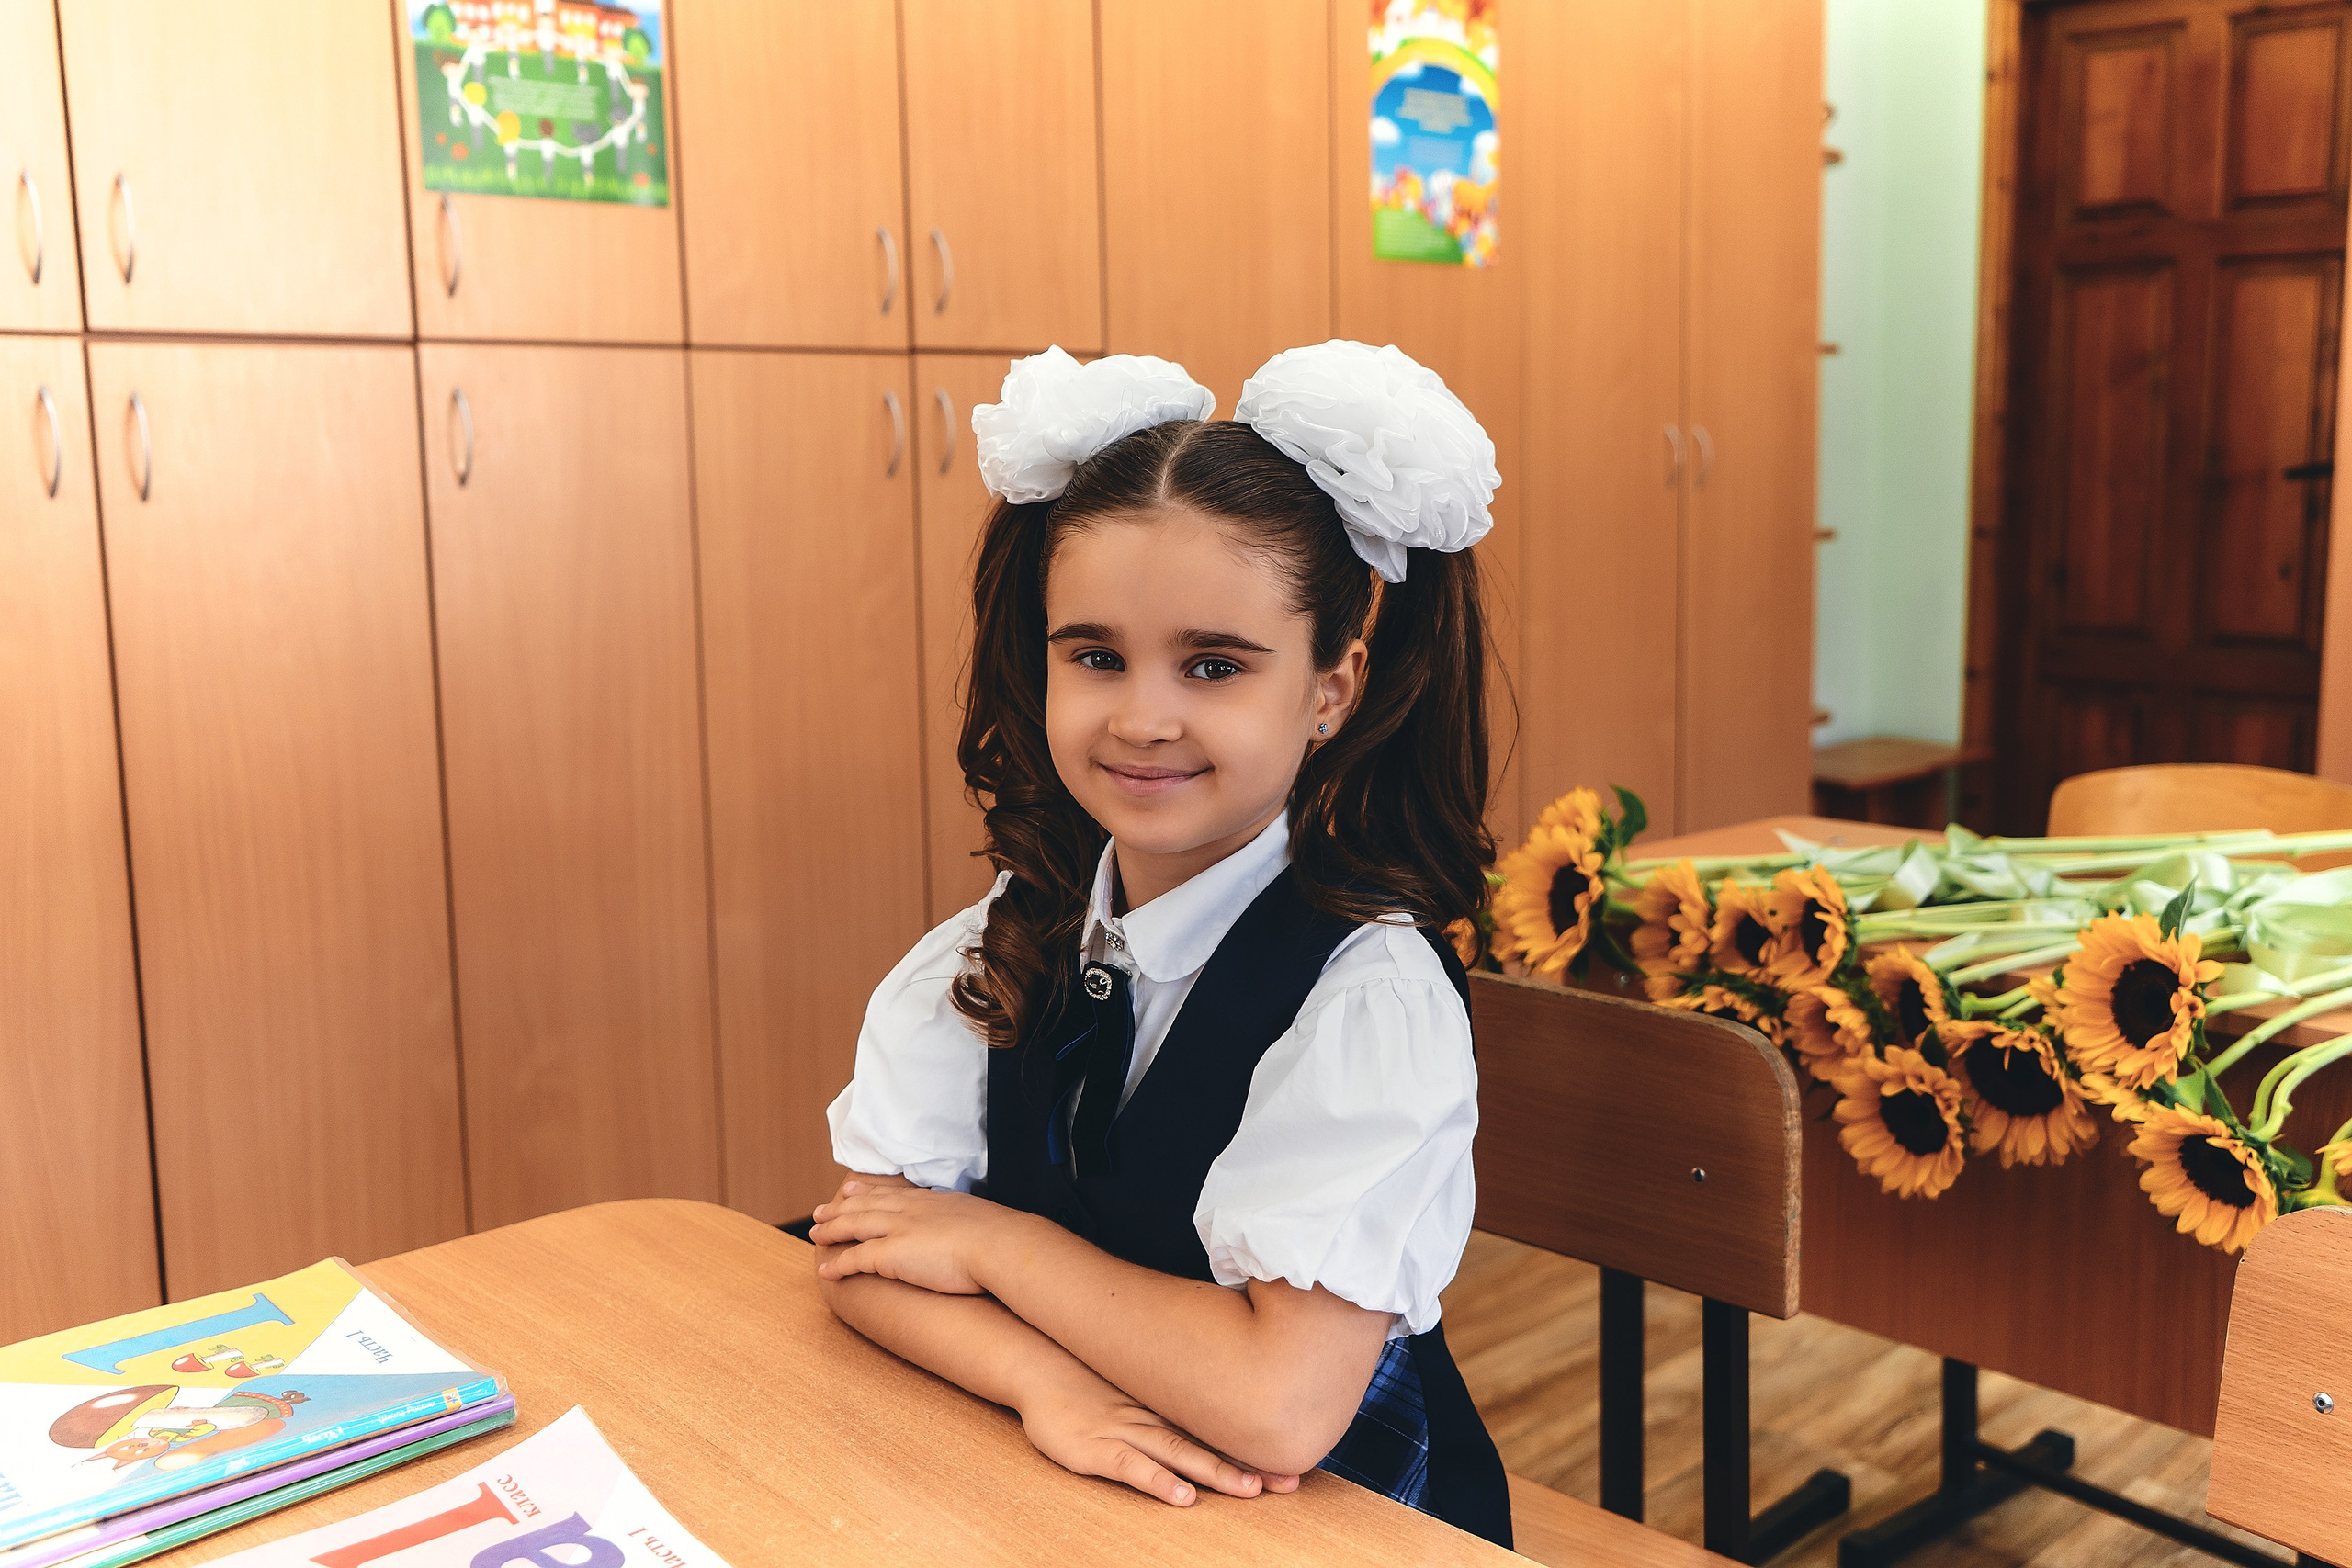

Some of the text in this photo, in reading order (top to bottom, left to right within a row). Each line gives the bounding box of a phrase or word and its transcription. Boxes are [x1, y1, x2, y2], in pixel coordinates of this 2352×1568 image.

[345, 1329, 393, 1364] Часть 1
[497, 1473, 542, 1518] класс
[627, 1526, 649, 1539] 1
